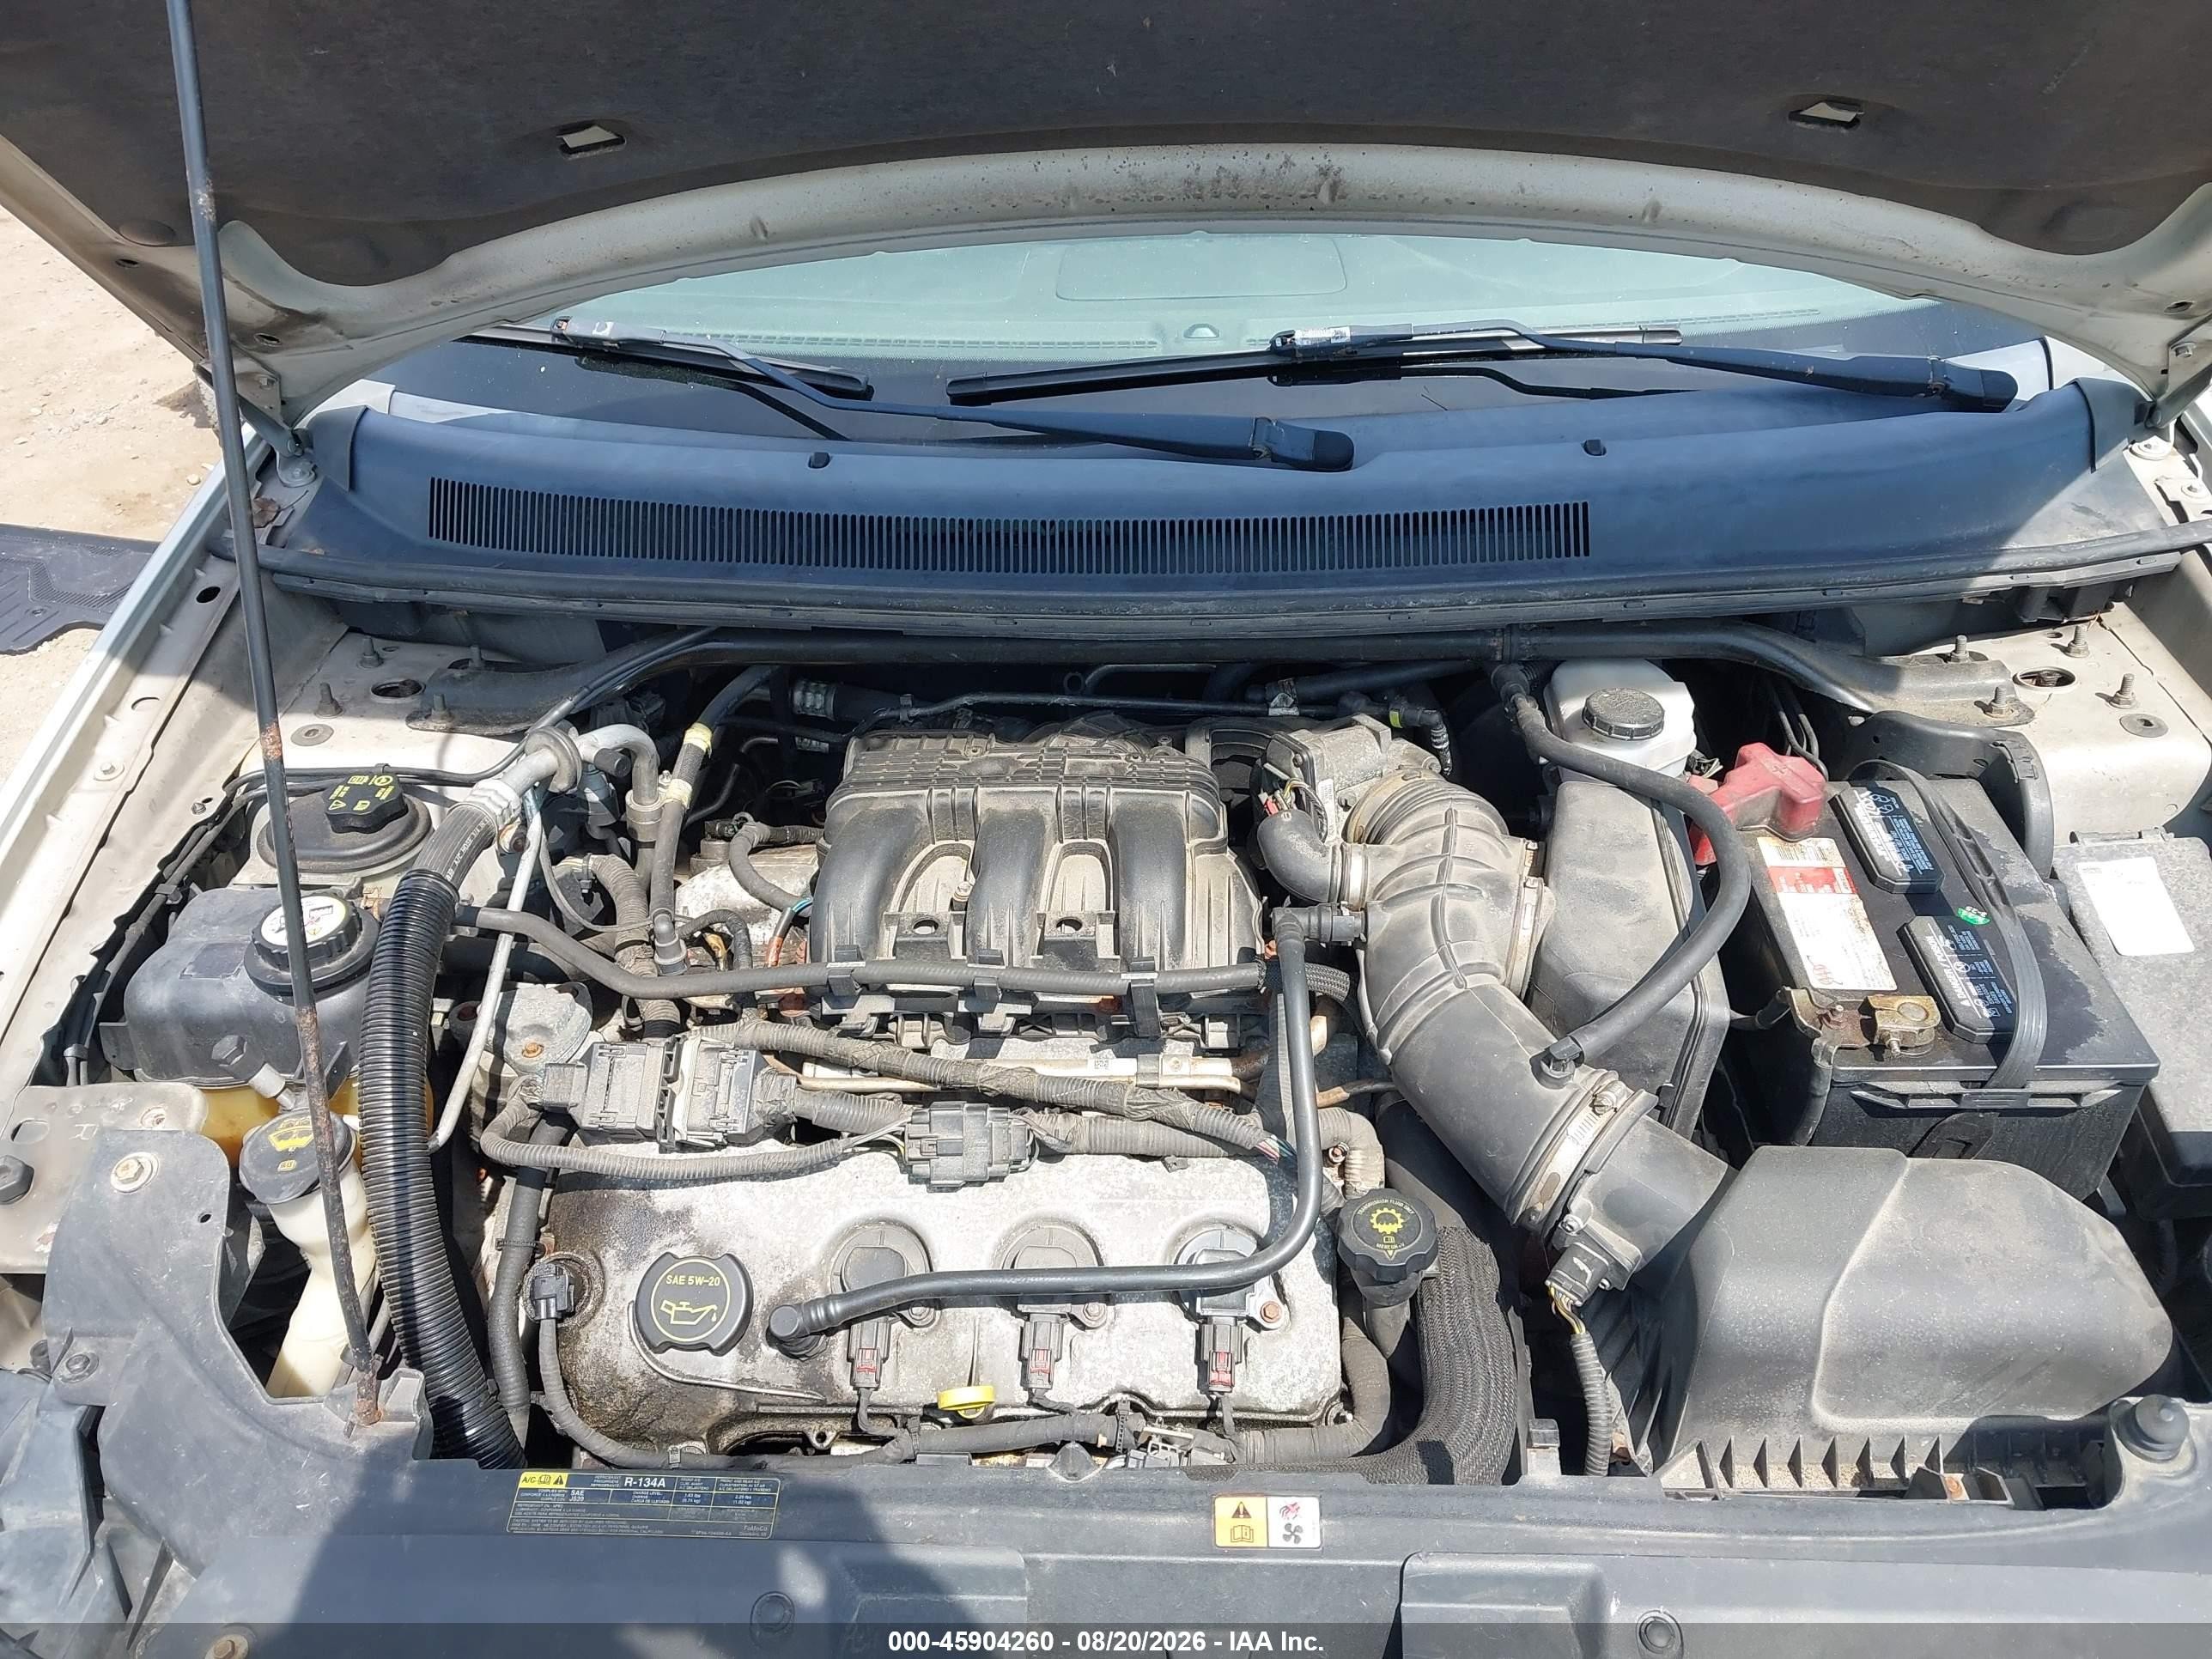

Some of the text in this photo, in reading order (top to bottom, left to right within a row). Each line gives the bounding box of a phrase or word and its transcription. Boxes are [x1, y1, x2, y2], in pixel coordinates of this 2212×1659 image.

[1924, 935, 1946, 961] POISON
[1942, 967, 1966, 998] DANGER
[666, 1275, 720, 1285] SAE 5W-20
[624, 1477, 665, 1487] R-134A
